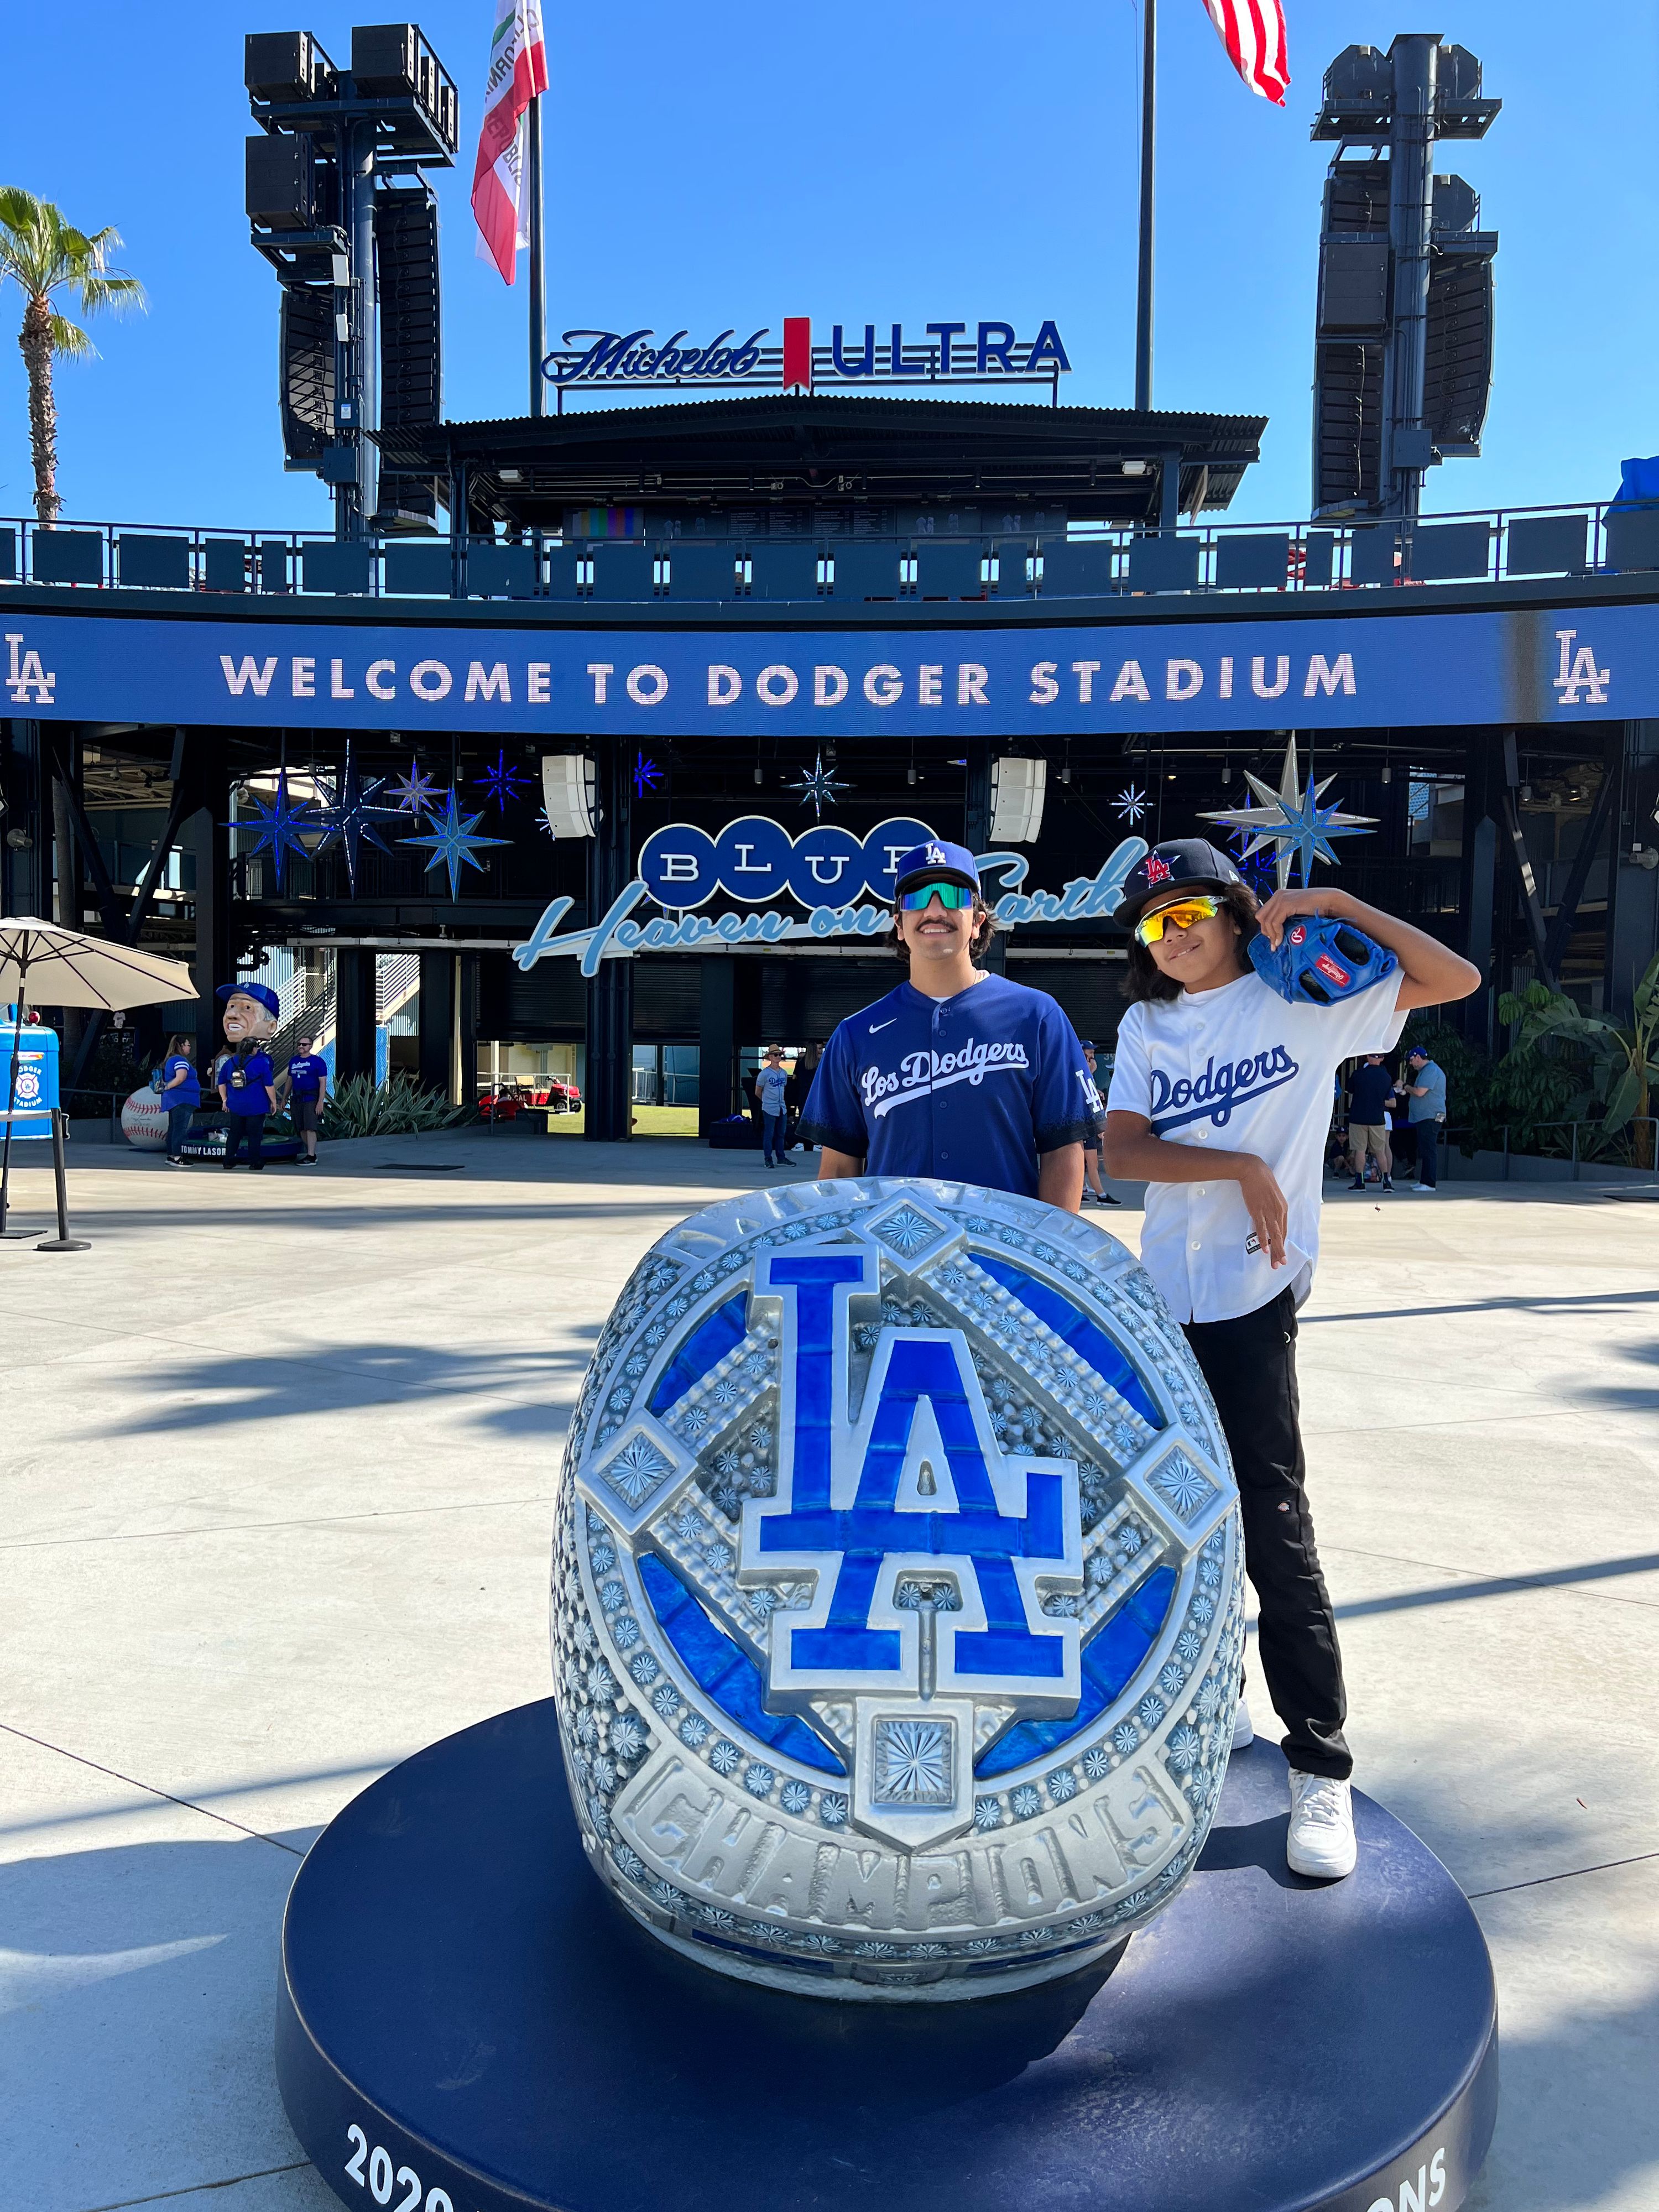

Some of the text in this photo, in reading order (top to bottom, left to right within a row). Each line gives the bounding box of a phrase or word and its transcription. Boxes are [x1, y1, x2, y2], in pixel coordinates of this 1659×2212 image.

[540, 320, 1073, 385] Michelob ULTRA
[4, 633, 55, 703] LA
[220, 653, 1357, 706] WELCOME TO DODGER STADIUM
[1553, 629, 1610, 704] LA
[925, 842, 946, 865] LA
[1145, 856, 1171, 885] LA
[512, 880, 794, 977] Heaven
[808, 904, 890, 939] on
[18, 1065, 42, 1076] ODGER
[861, 1037, 1029, 1107] Los Dodgers
[1075, 1069, 1104, 1114] LA
[203, 1147, 226, 1156] LASOR
[740, 1244, 1082, 1693] LA
[630, 1761, 1185, 1929] CHAMPIONS
